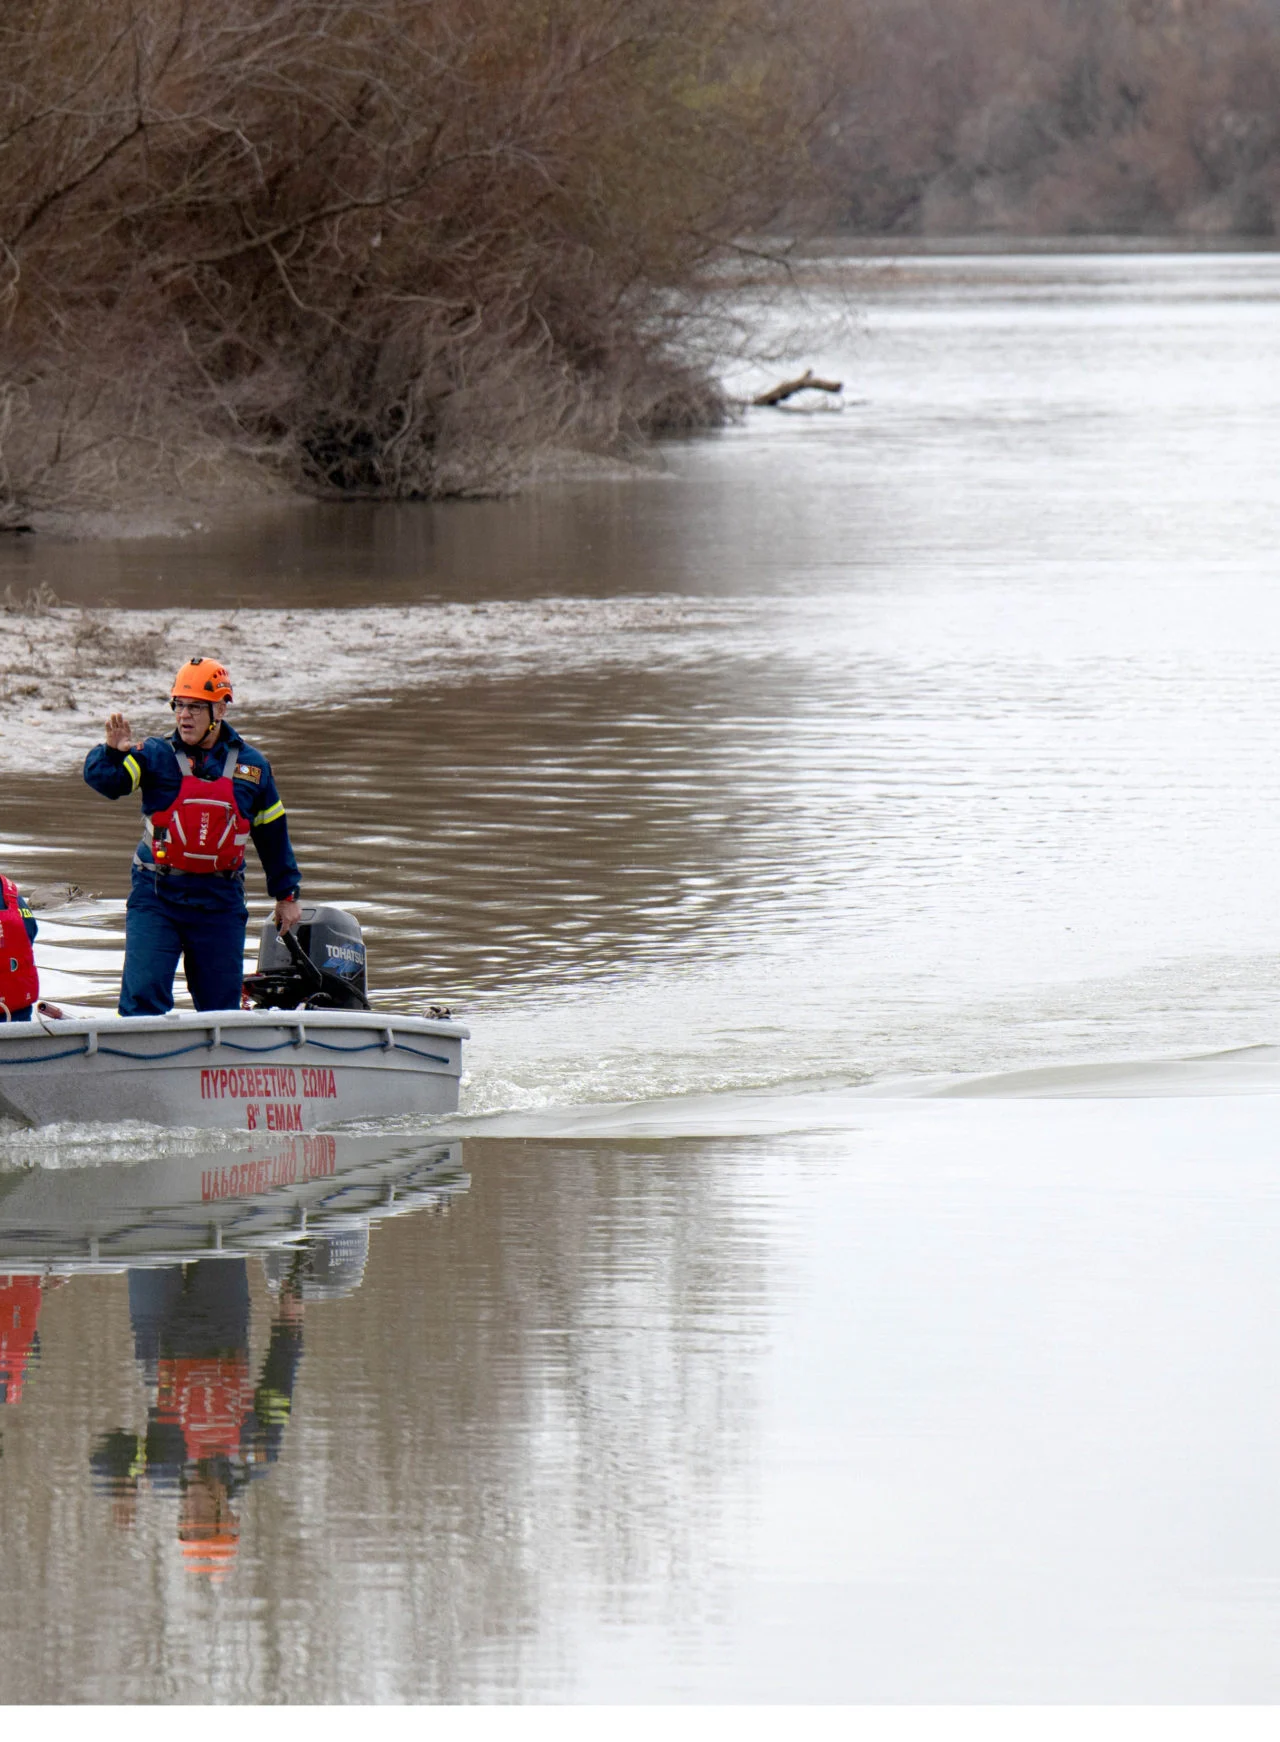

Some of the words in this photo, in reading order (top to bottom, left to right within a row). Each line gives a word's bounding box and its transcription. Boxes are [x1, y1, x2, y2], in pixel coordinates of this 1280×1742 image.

[325, 944, 364, 965] TOHATSU
[201, 1068, 297, 1099] ΠΥΡΟΣΒΕΣΤΙΚΟ
[301, 1068, 337, 1098] ΣΩΜΑ
[265, 1104, 304, 1131] ΕΜΑΚ
